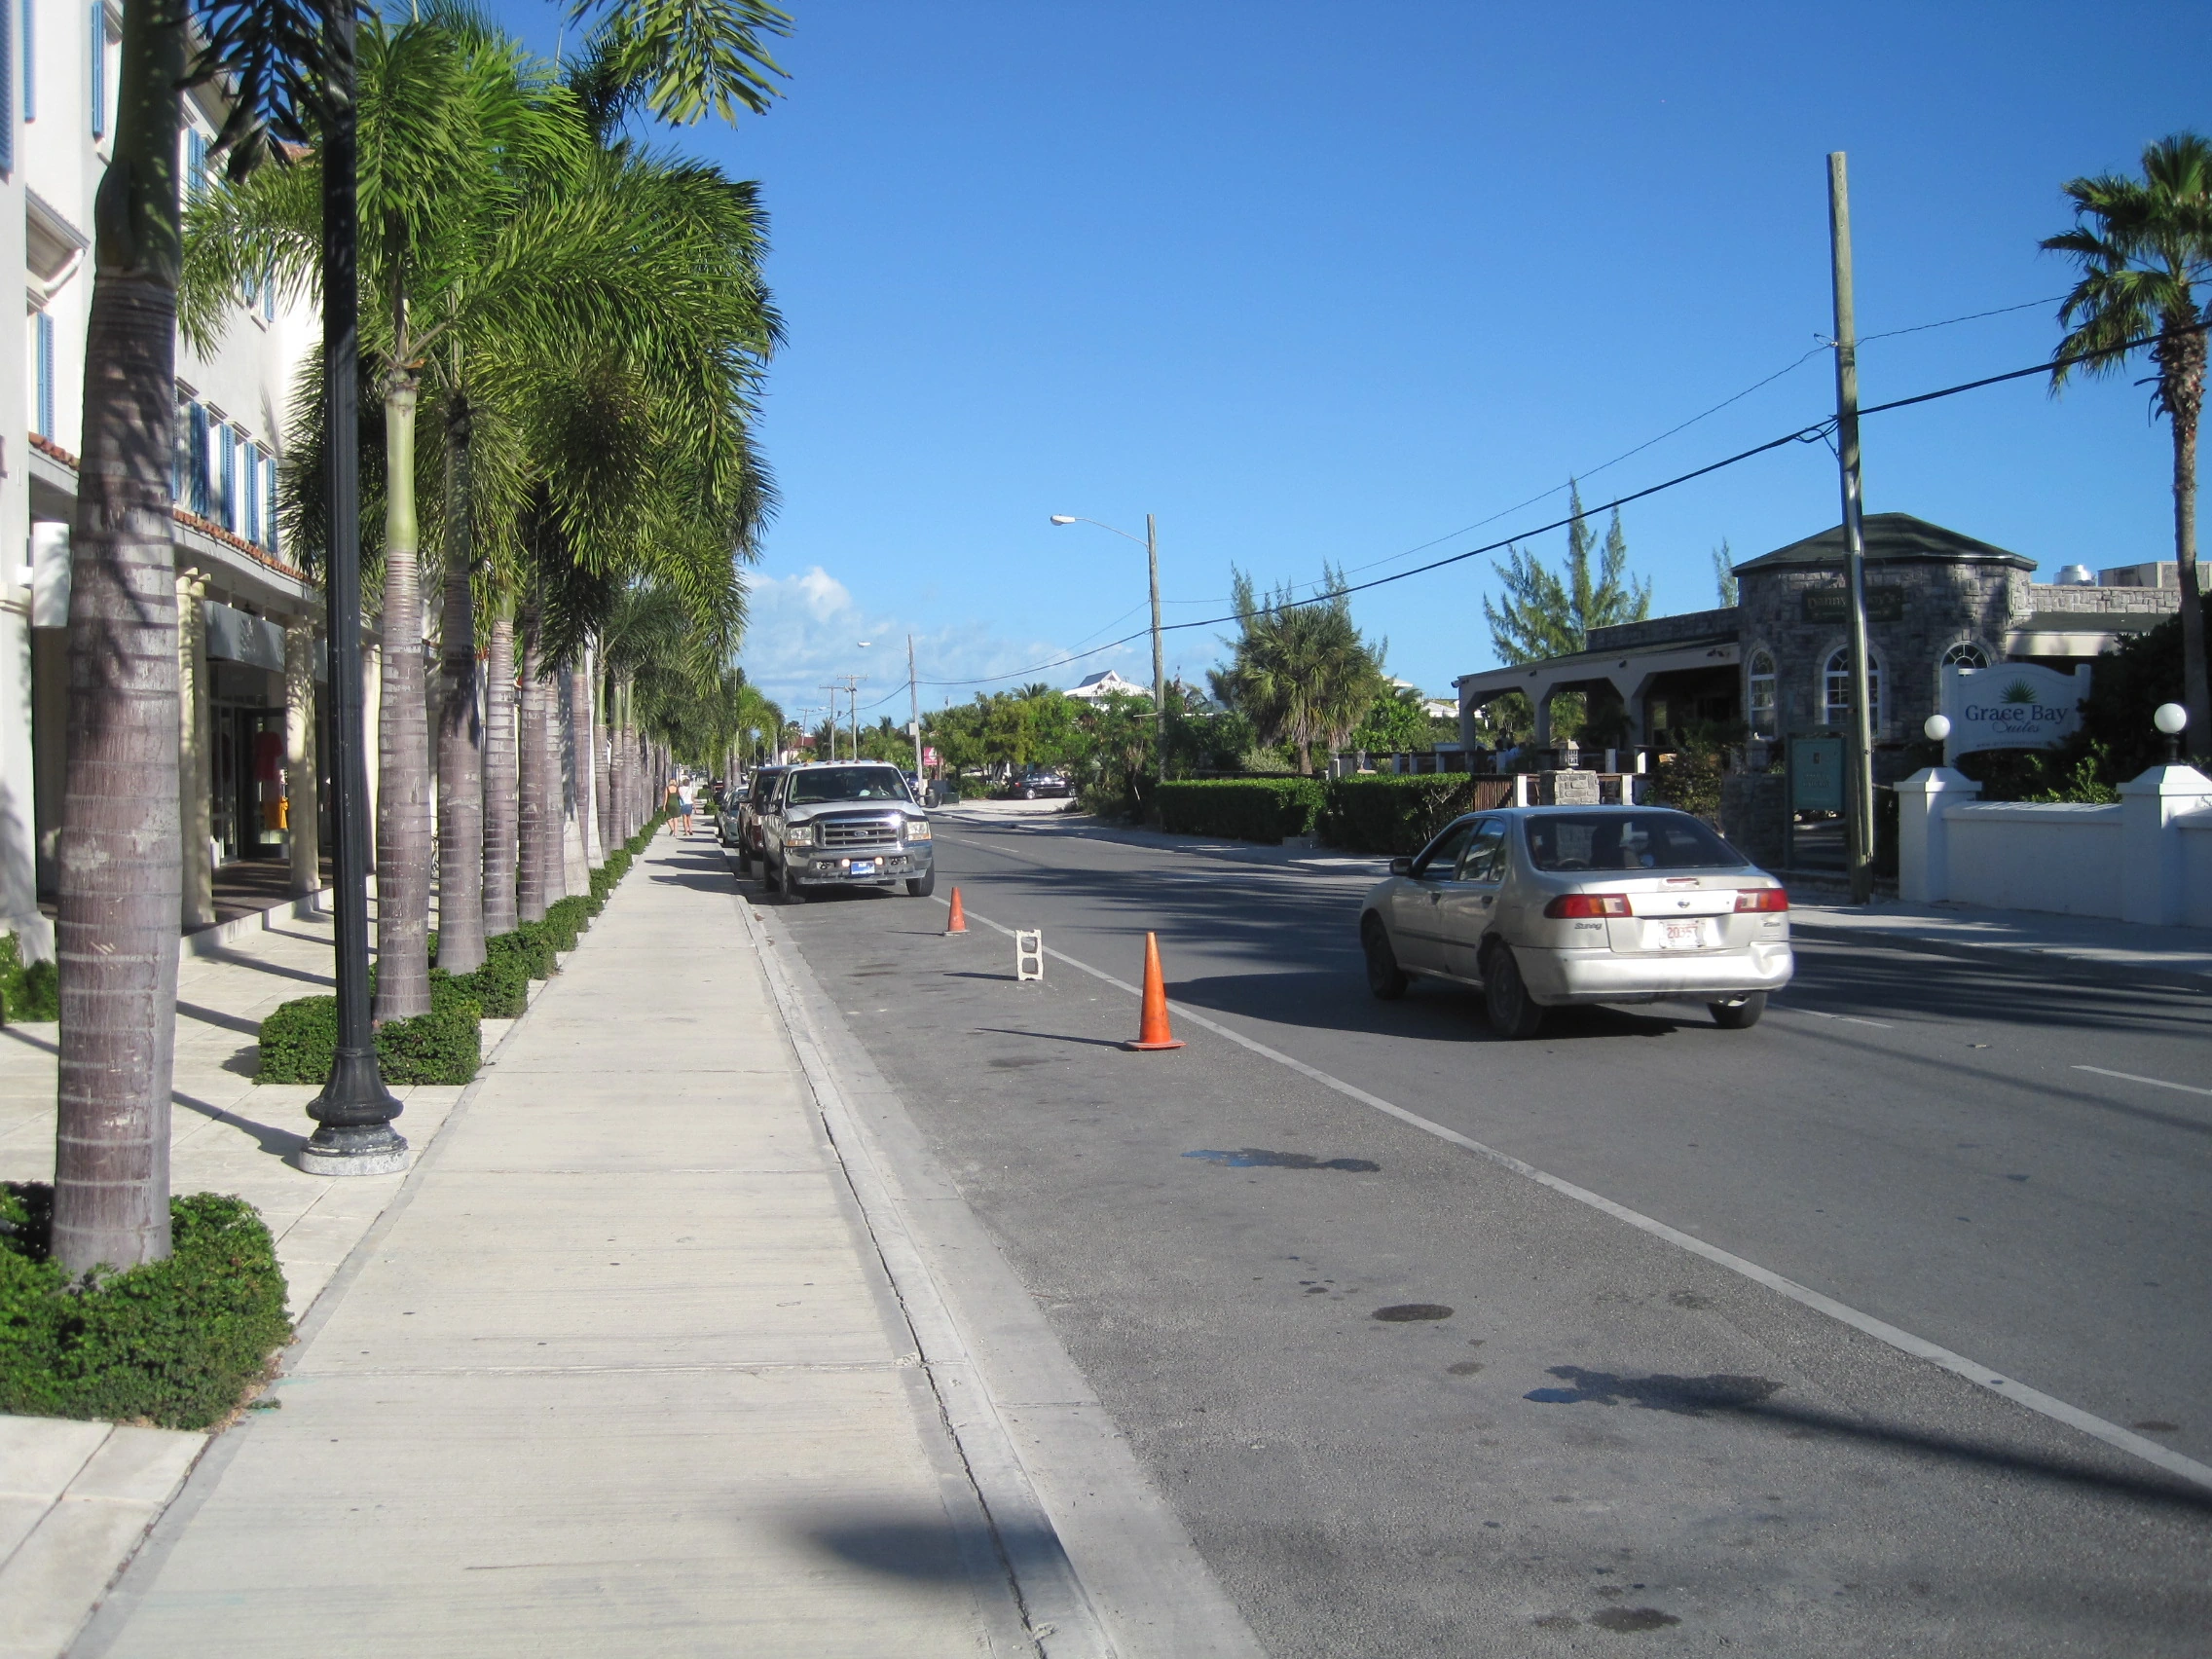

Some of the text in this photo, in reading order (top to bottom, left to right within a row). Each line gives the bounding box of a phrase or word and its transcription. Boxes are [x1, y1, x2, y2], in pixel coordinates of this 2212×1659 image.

[1965, 704, 2069, 724] Grace Bay
[1992, 714, 2041, 733] Suites
